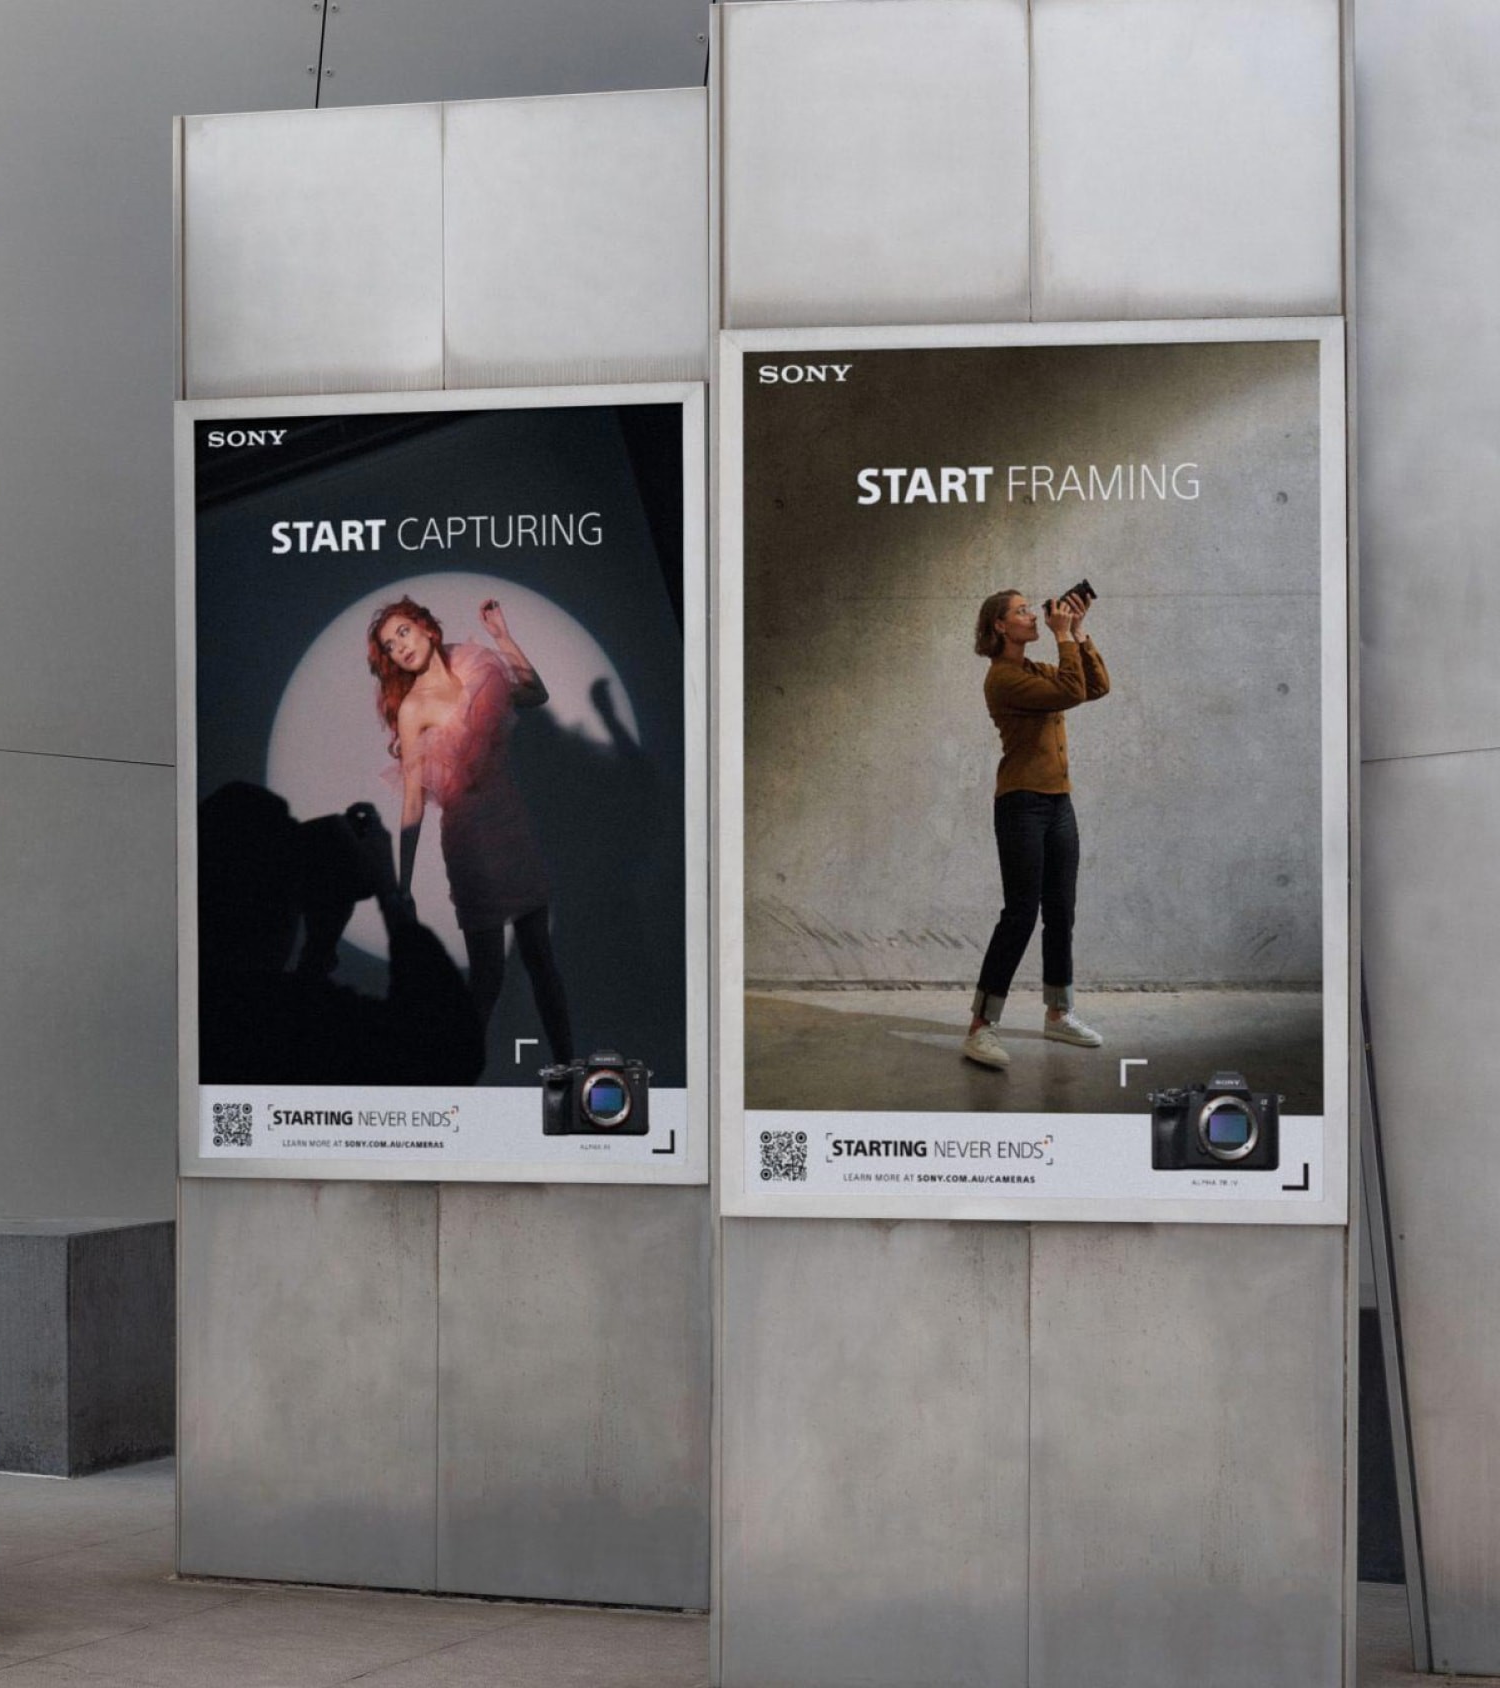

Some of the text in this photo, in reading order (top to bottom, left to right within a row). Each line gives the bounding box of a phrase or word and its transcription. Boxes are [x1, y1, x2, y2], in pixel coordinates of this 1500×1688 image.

[758, 364, 853, 384] SONY
[207, 429, 287, 448] SONY
[857, 462, 1200, 505] START FRAMING
[271, 511, 602, 555] START CAPTURING
[273, 1110, 451, 1127] STARTING NEVER ENDS
[282, 1139, 444, 1149] LEARN MORE AT SONY.COM.AU/CAMERAS
[832, 1139, 1044, 1159] STARTING NEVER ENDS
[843, 1173, 1036, 1184] LEARN MORE AT SONY.COM.AU/CAMERAS
